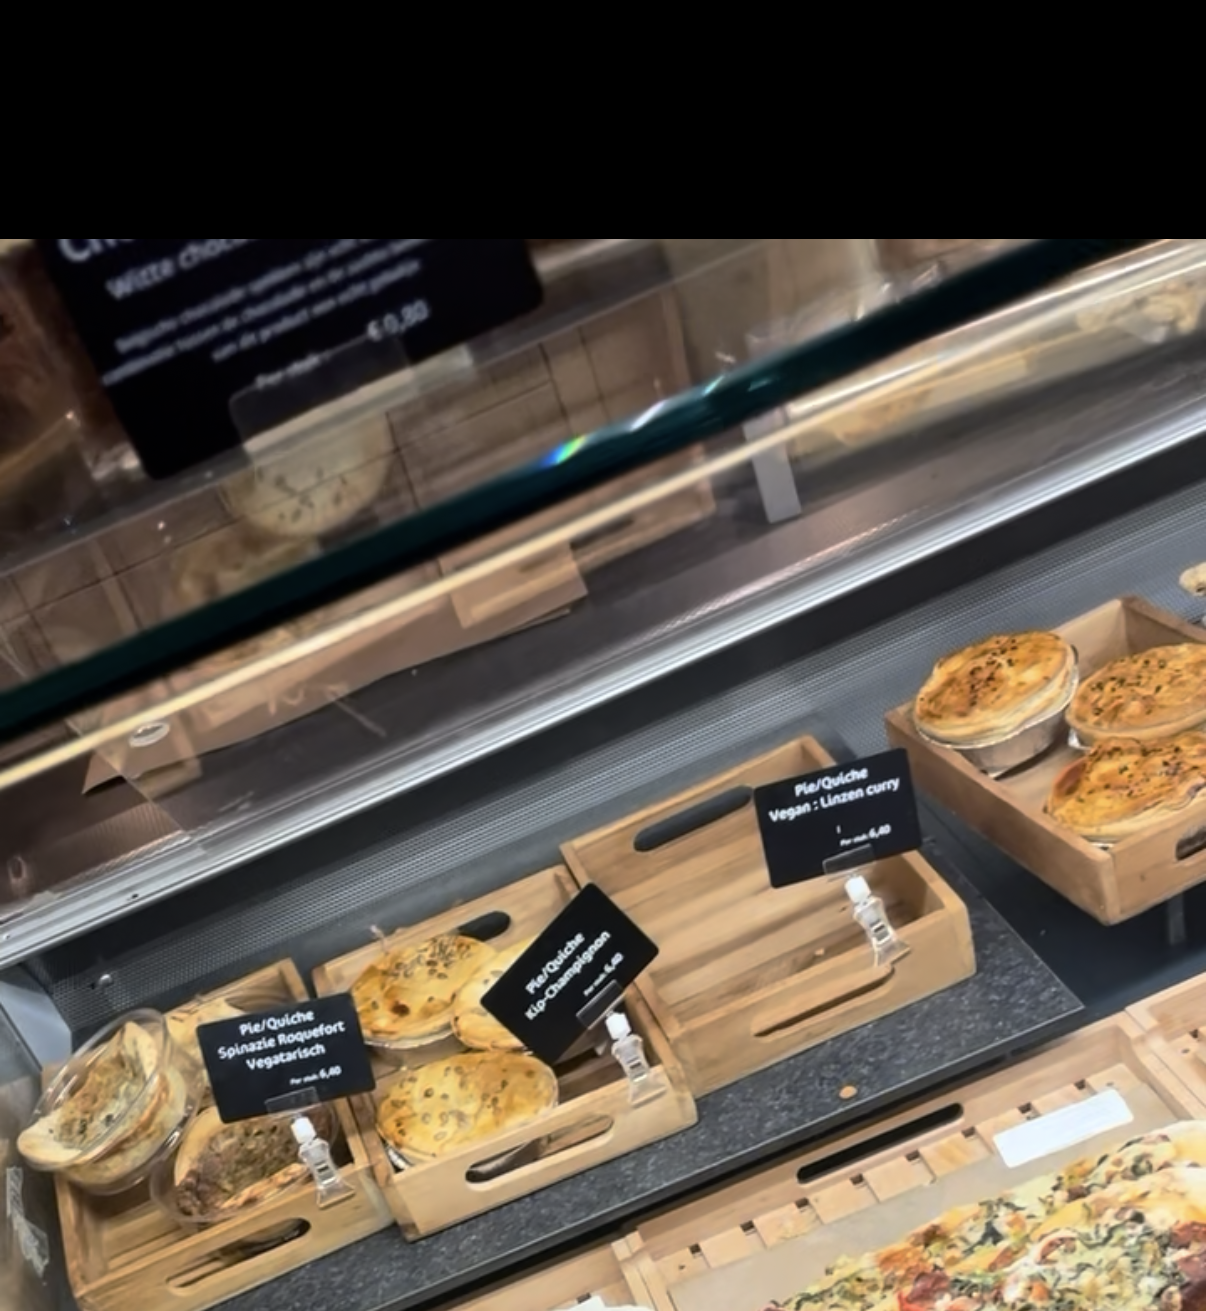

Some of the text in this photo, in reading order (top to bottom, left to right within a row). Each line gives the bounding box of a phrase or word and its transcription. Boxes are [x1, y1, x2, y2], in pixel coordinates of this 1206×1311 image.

[106, 258, 174, 300] Witte
[383, 299, 429, 335] 0,80
[768, 801, 811, 822] Vegan
[819, 787, 865, 809] Linzen
[865, 777, 900, 797] curry
[794, 767, 868, 798] Pie/Quiche
[868, 823, 892, 840] 6,40
[524, 931, 586, 996] Pie/Quiche
[524, 930, 612, 1021] Kip-Champignon
[217, 1020, 346, 1060] Spinazie Roquefort
[239, 1010, 315, 1036] Pie/Quiche
[246, 1043, 326, 1071] Vegatarisch
[319, 1065, 342, 1080] 6,40
